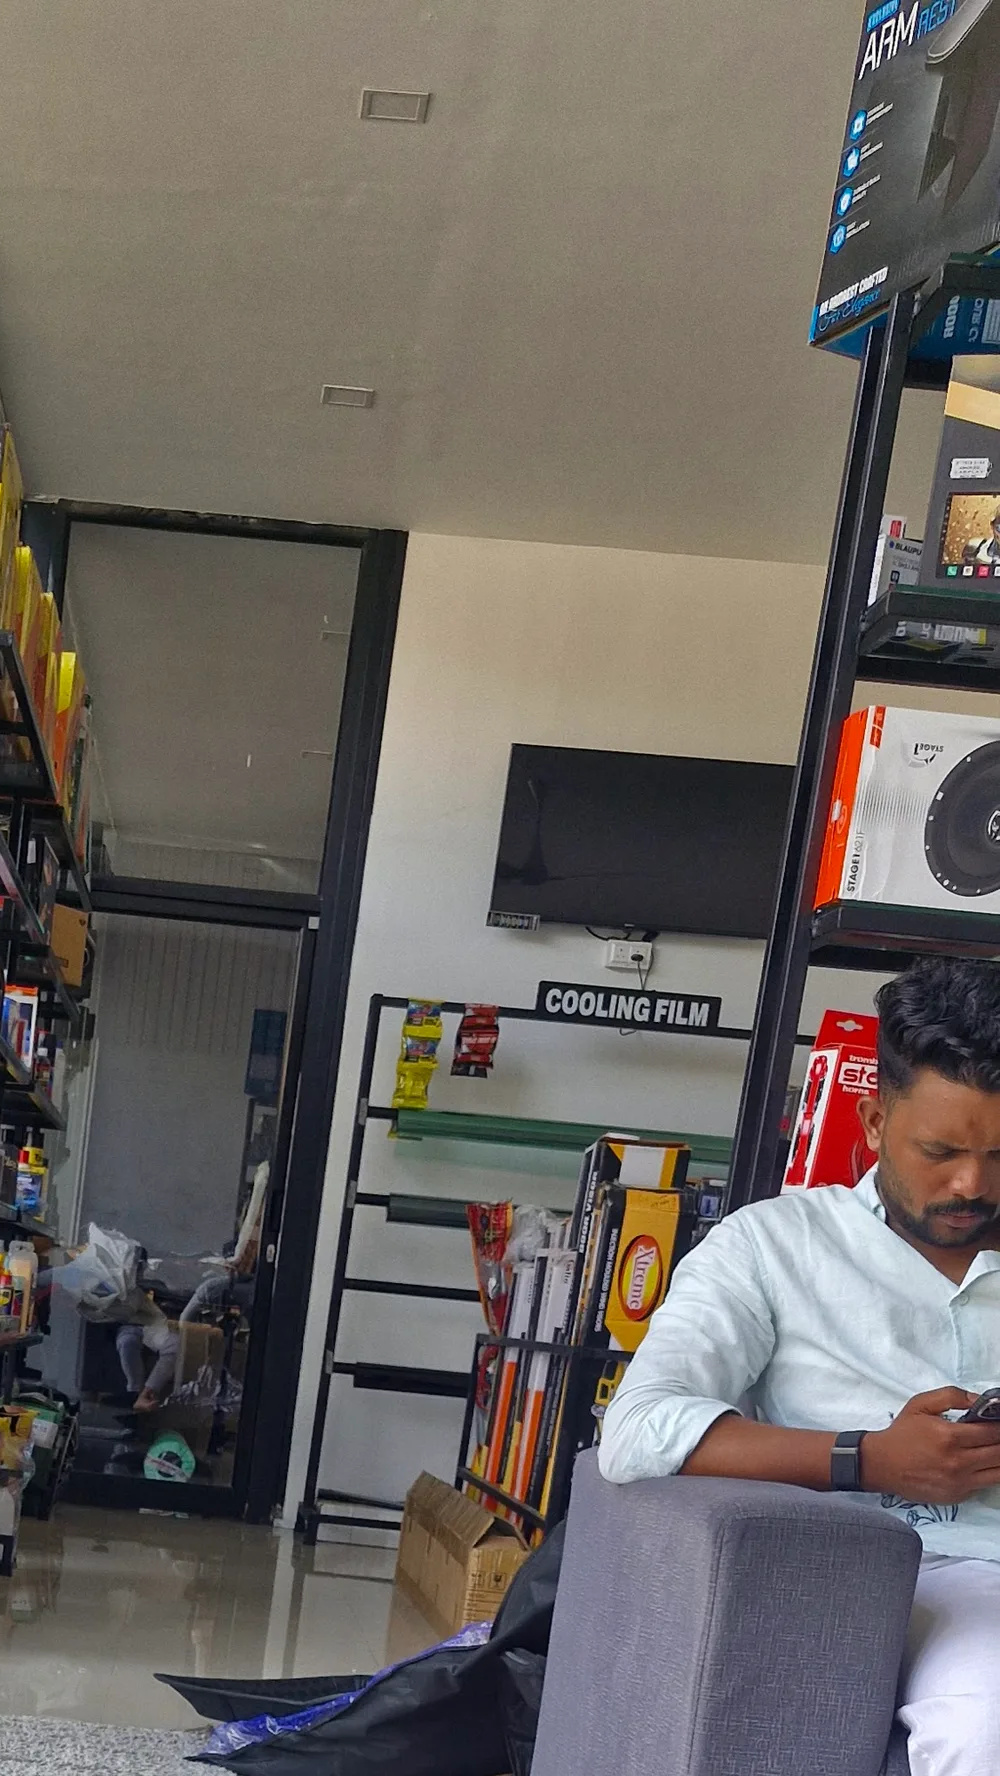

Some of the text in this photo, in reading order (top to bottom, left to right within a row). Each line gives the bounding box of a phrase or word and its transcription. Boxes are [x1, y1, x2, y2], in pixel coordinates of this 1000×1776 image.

[858, 1, 919, 80] ARM
[545, 988, 711, 1028] COOLING FILM
[579, 1171, 599, 1254] DOOR VISOR
[626, 1244, 656, 1311] Xtreme
